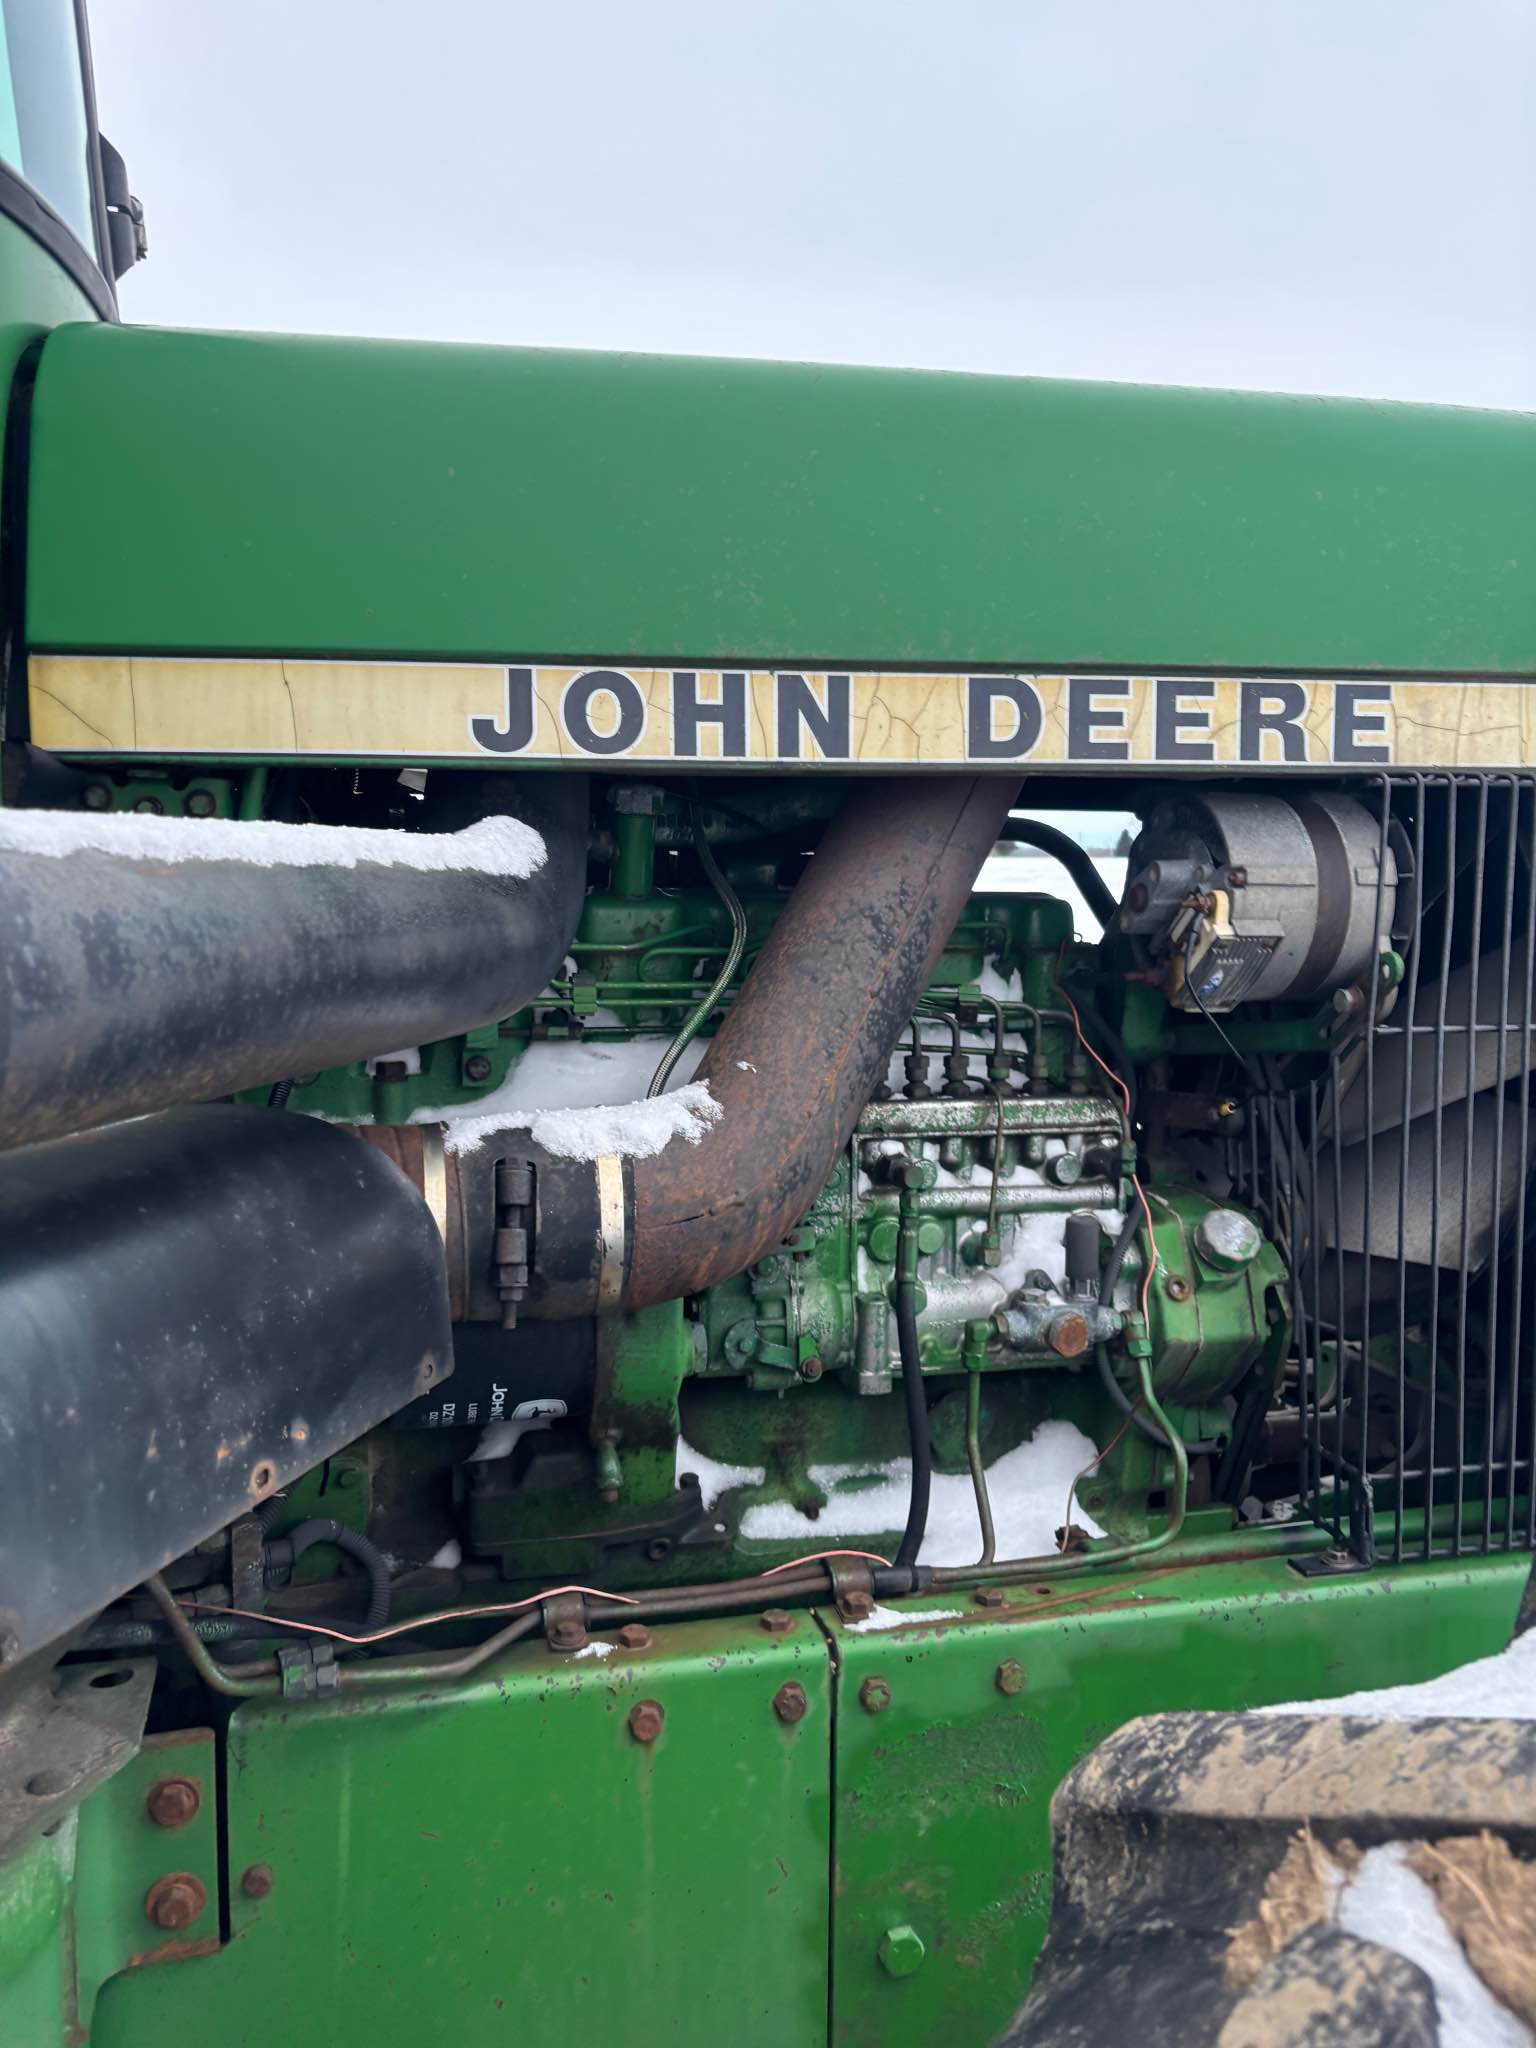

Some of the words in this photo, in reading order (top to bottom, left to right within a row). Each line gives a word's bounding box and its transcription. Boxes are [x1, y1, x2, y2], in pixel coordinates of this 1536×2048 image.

[471, 667, 851, 759] JOHN
[967, 677, 1393, 764] DEERE
[490, 1383, 508, 1416] JOHN
